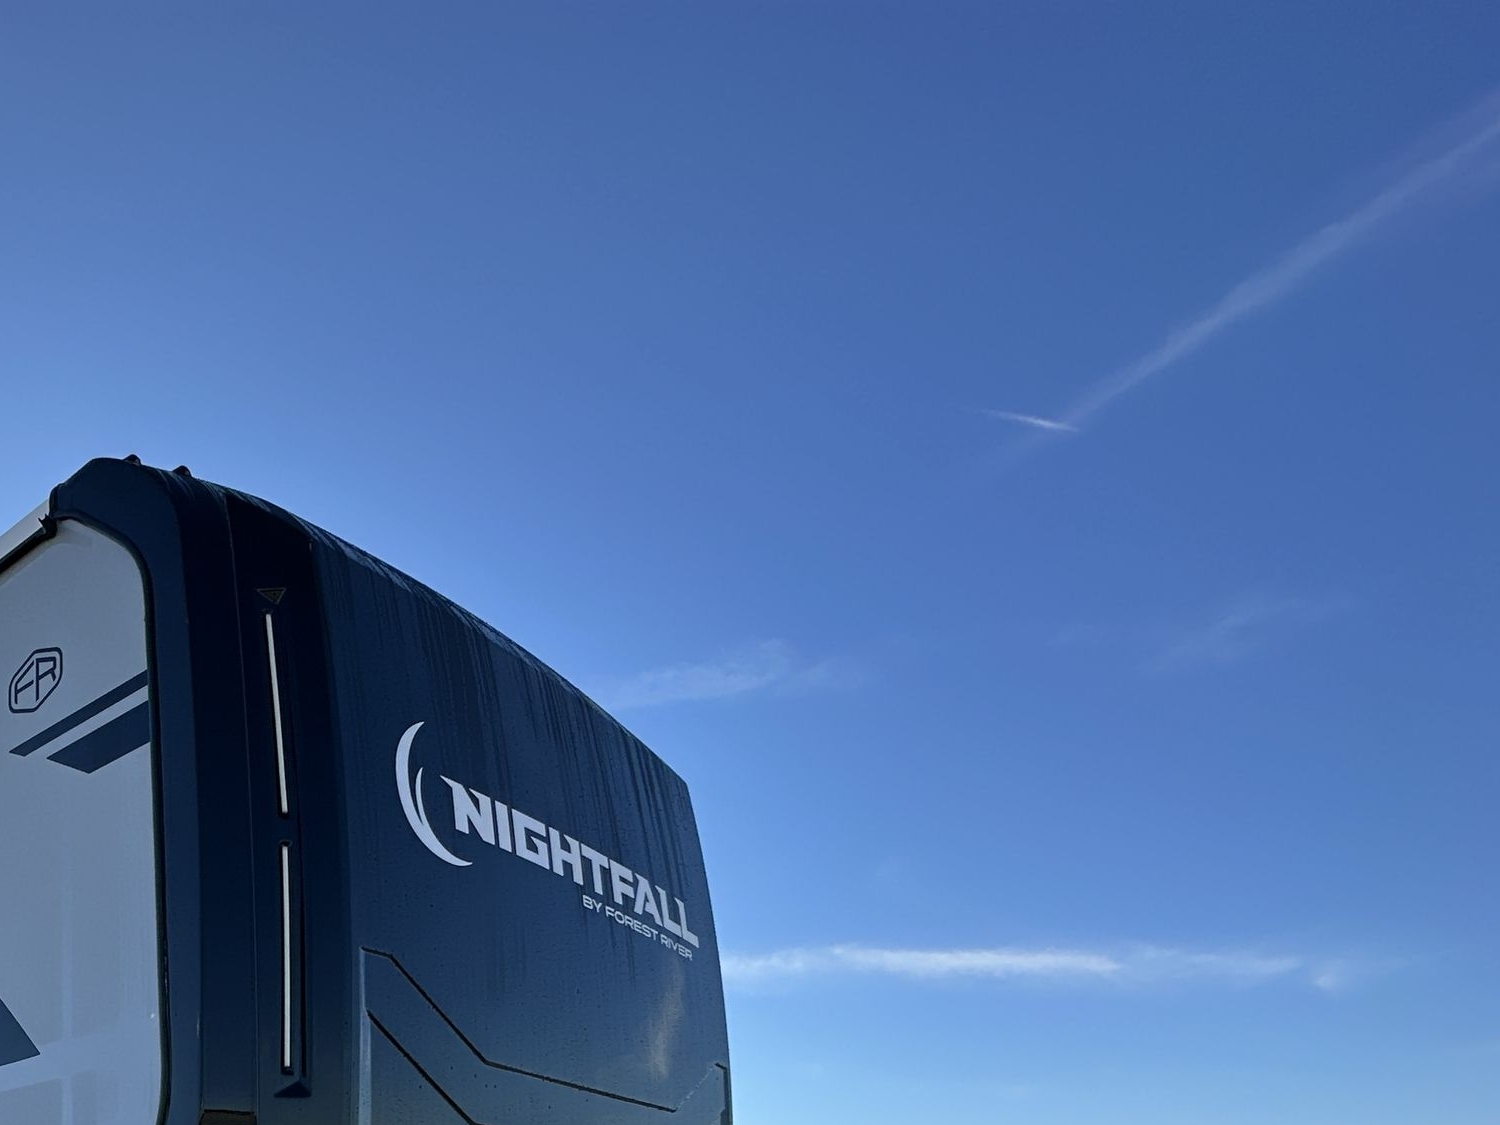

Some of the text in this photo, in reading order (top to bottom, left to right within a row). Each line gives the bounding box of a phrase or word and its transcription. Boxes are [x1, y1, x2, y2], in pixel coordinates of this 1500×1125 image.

[439, 774, 699, 949] NIGHTFALL
[582, 894, 693, 961] BY FOREST RIVER
